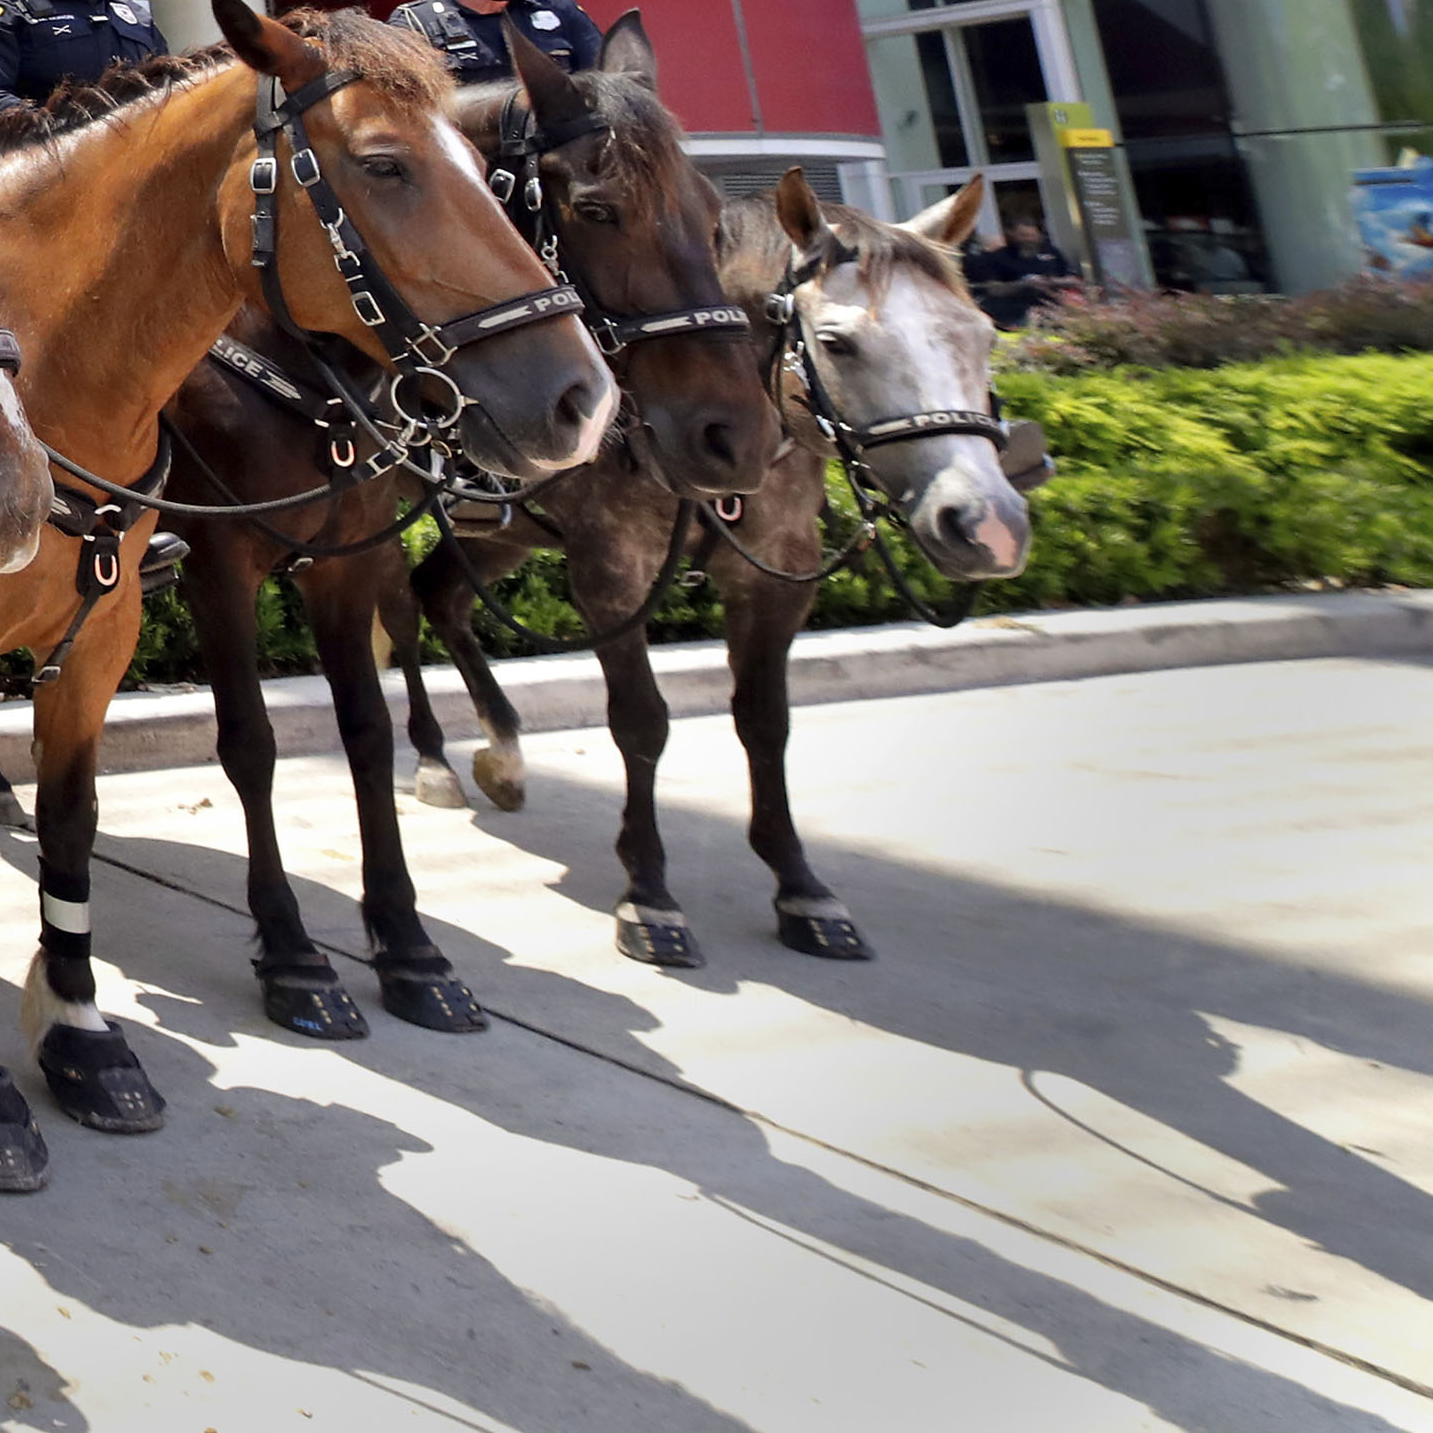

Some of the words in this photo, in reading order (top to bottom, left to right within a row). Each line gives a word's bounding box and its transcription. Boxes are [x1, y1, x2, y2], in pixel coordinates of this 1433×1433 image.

[534, 290, 583, 312] POL
[213, 339, 263, 378] LICE
[913, 412, 997, 427] POLIC
